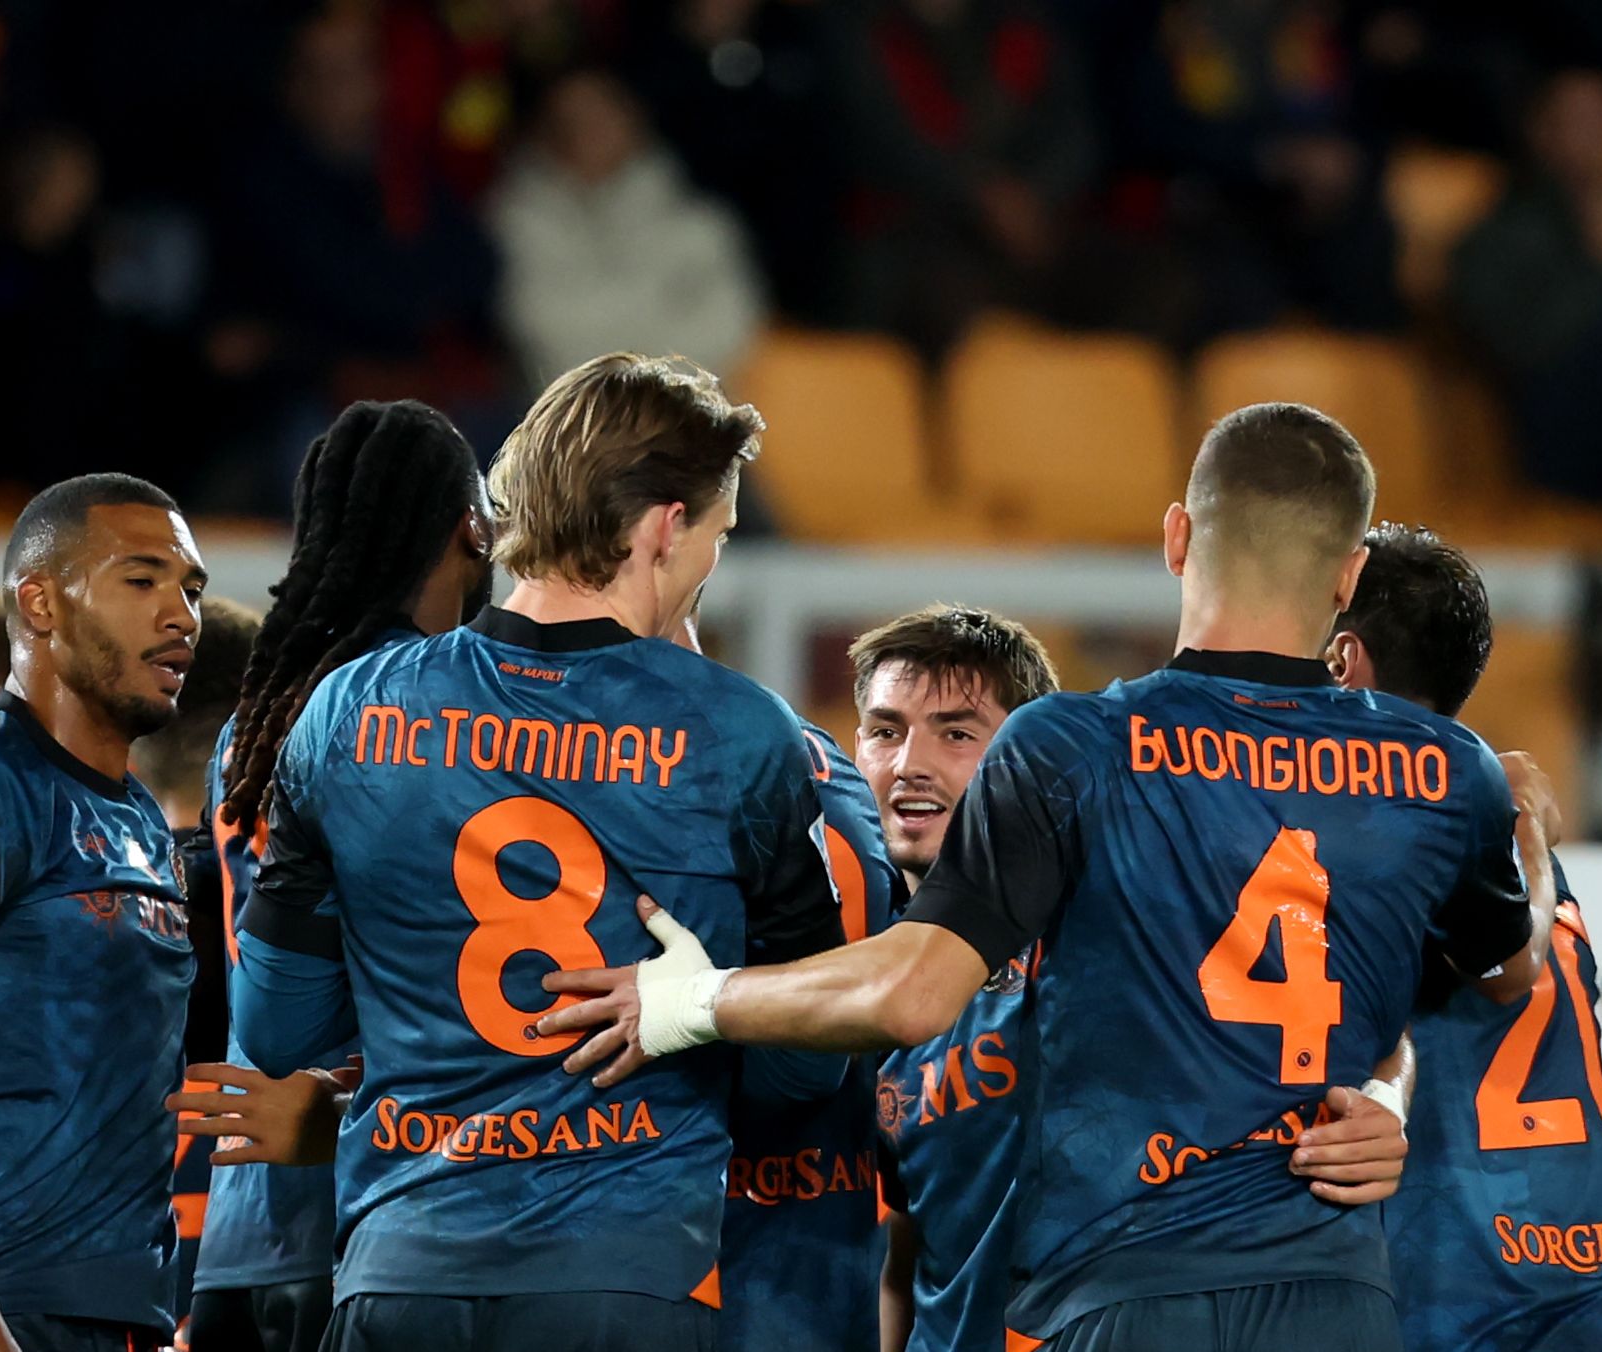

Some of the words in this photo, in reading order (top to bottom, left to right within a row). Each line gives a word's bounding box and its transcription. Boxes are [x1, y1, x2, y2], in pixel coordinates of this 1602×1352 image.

[1130, 713, 1448, 803] BUONGIORNO
[452, 795, 607, 1057] 8
[1198, 824, 1342, 1085] 4
[918, 1031, 1018, 1126] MS
